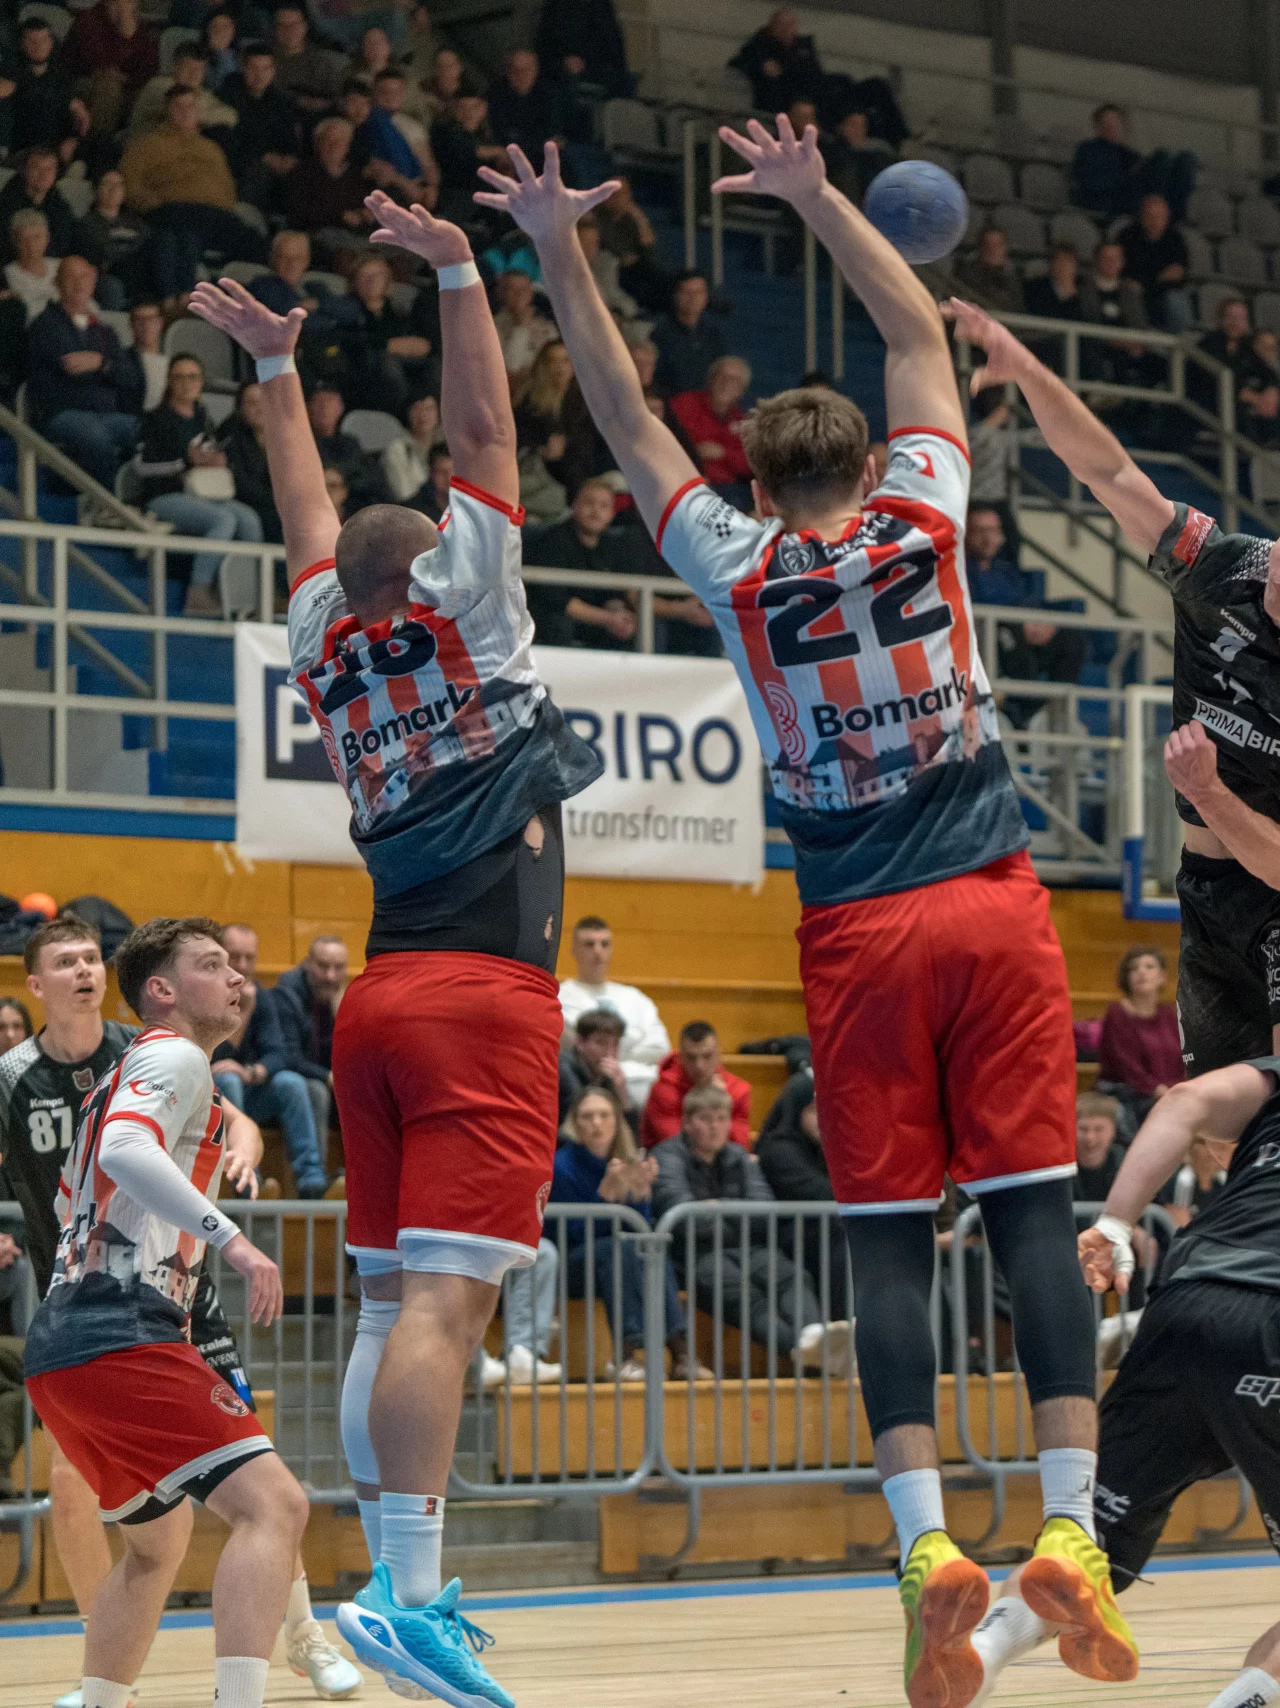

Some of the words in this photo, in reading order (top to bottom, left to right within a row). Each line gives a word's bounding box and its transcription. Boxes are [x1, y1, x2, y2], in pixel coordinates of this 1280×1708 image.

[757, 547, 956, 668] 22
[1220, 608, 1257, 642] Kempa
[341, 682, 476, 768] Bomark
[811, 665, 967, 739] Bomark
[567, 803, 737, 844] transformer
[29, 1097, 65, 1110] Kempa
[28, 1106, 73, 1155] 87
